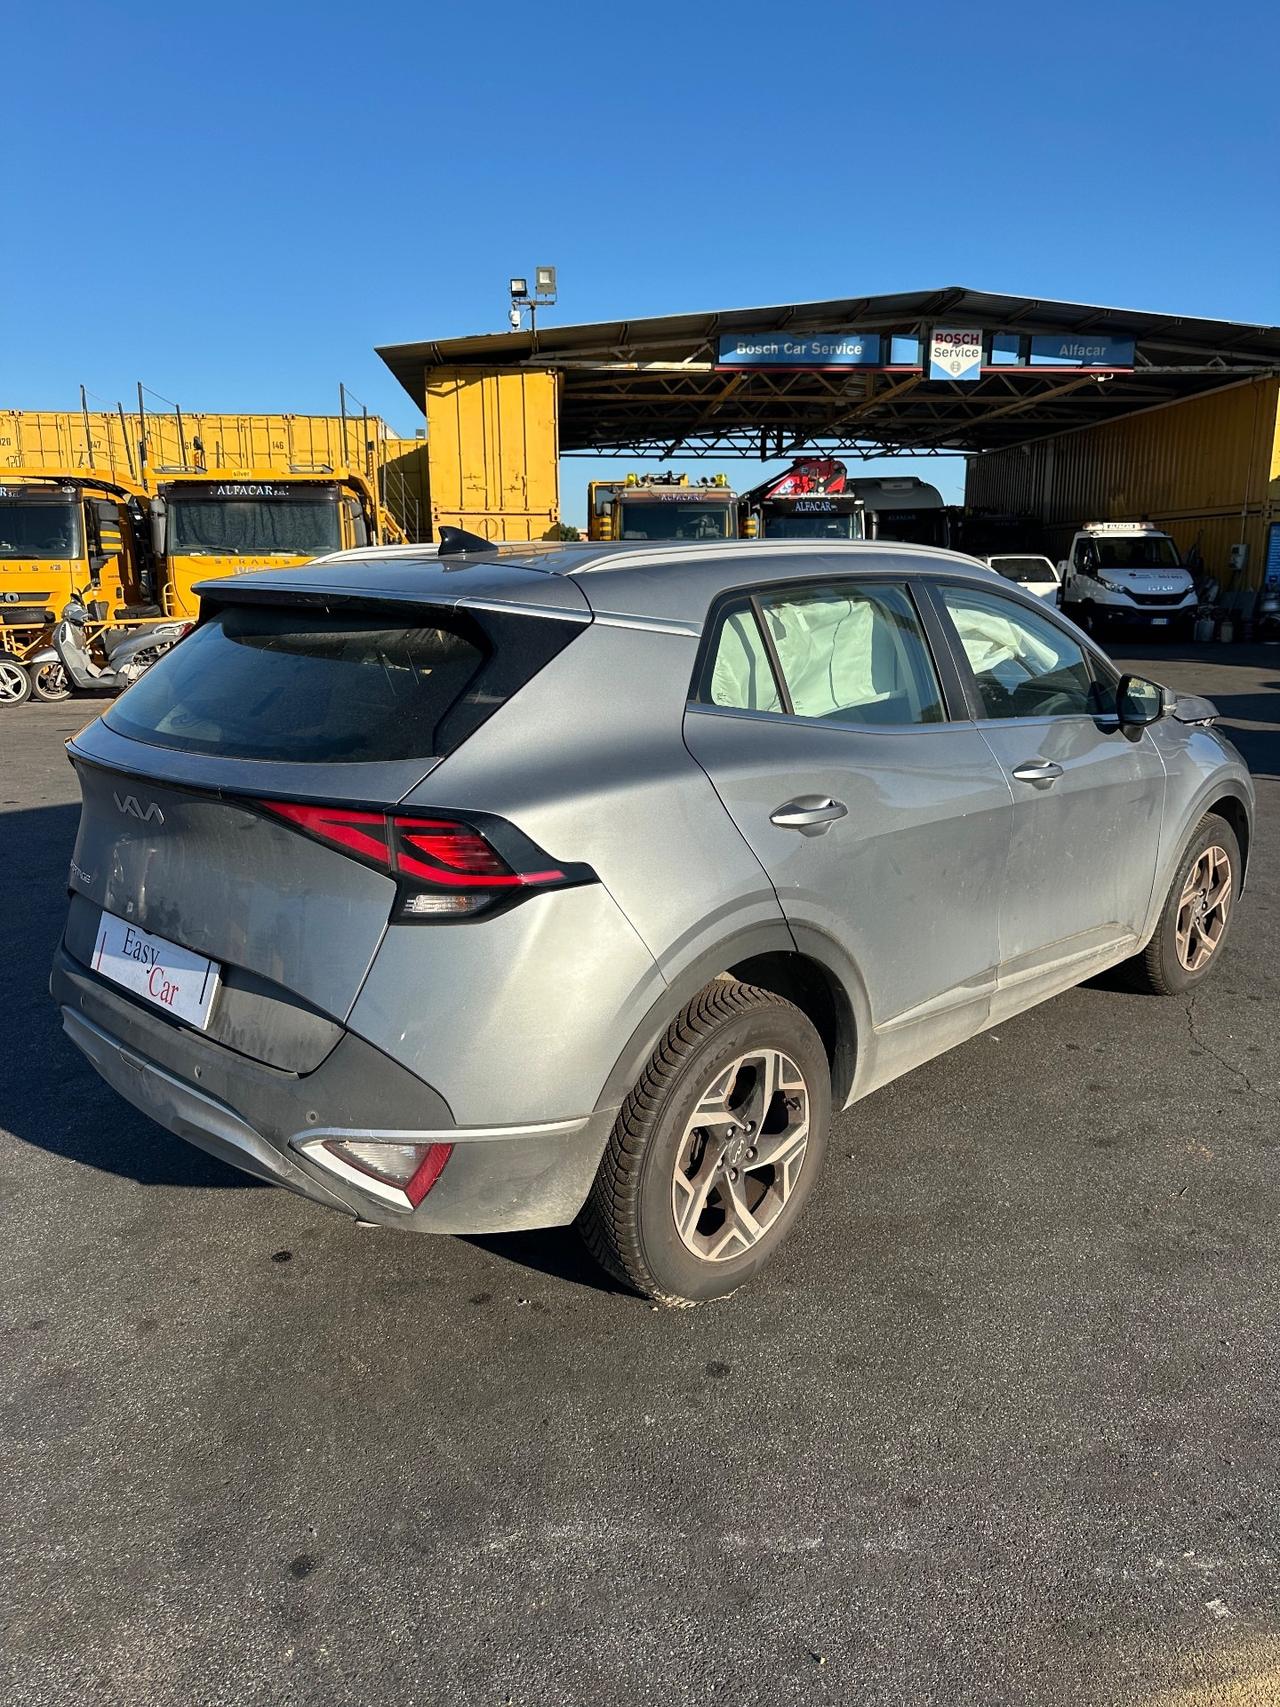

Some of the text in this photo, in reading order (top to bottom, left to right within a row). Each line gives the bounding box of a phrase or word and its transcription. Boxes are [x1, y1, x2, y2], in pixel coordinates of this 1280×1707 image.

[935, 333, 980, 345] BOSCH
[736, 342, 863, 355] Bosch Car Service
[933, 347, 980, 358] Service
[1059, 343, 1107, 357] Alfacar
[272, 441, 284, 450] 146
[217, 485, 273, 496] ALFACAR
[795, 501, 832, 512] ALFACAR
[122, 926, 160, 975] Easy
[148, 966, 180, 1006] Car
